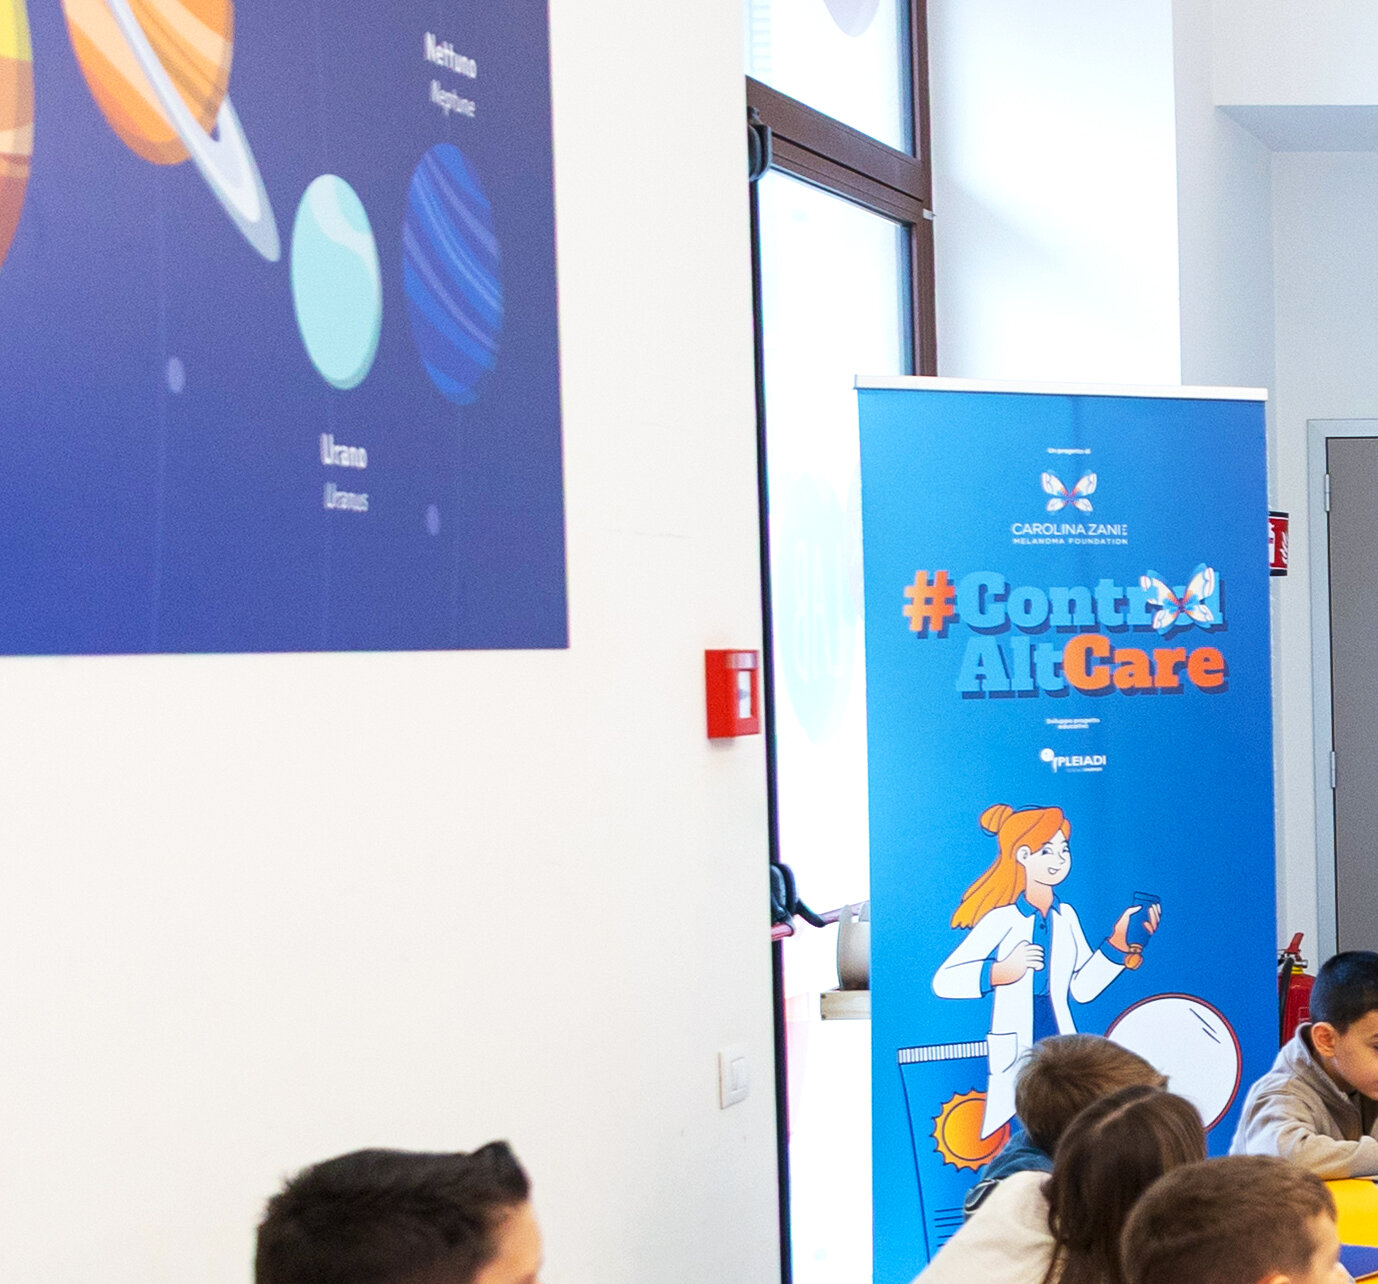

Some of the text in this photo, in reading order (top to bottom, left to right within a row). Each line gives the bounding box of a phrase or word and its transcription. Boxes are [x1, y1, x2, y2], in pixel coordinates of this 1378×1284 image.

[424, 31, 477, 79] Nettuno
[430, 79, 476, 117] Neptune
[321, 433, 368, 469] Urano
[324, 482, 369, 511] Uranus
[1012, 523, 1086, 535] CAROLINA
[956, 633, 1226, 692] AltCare
[1058, 755, 1107, 767] PLEIADI
